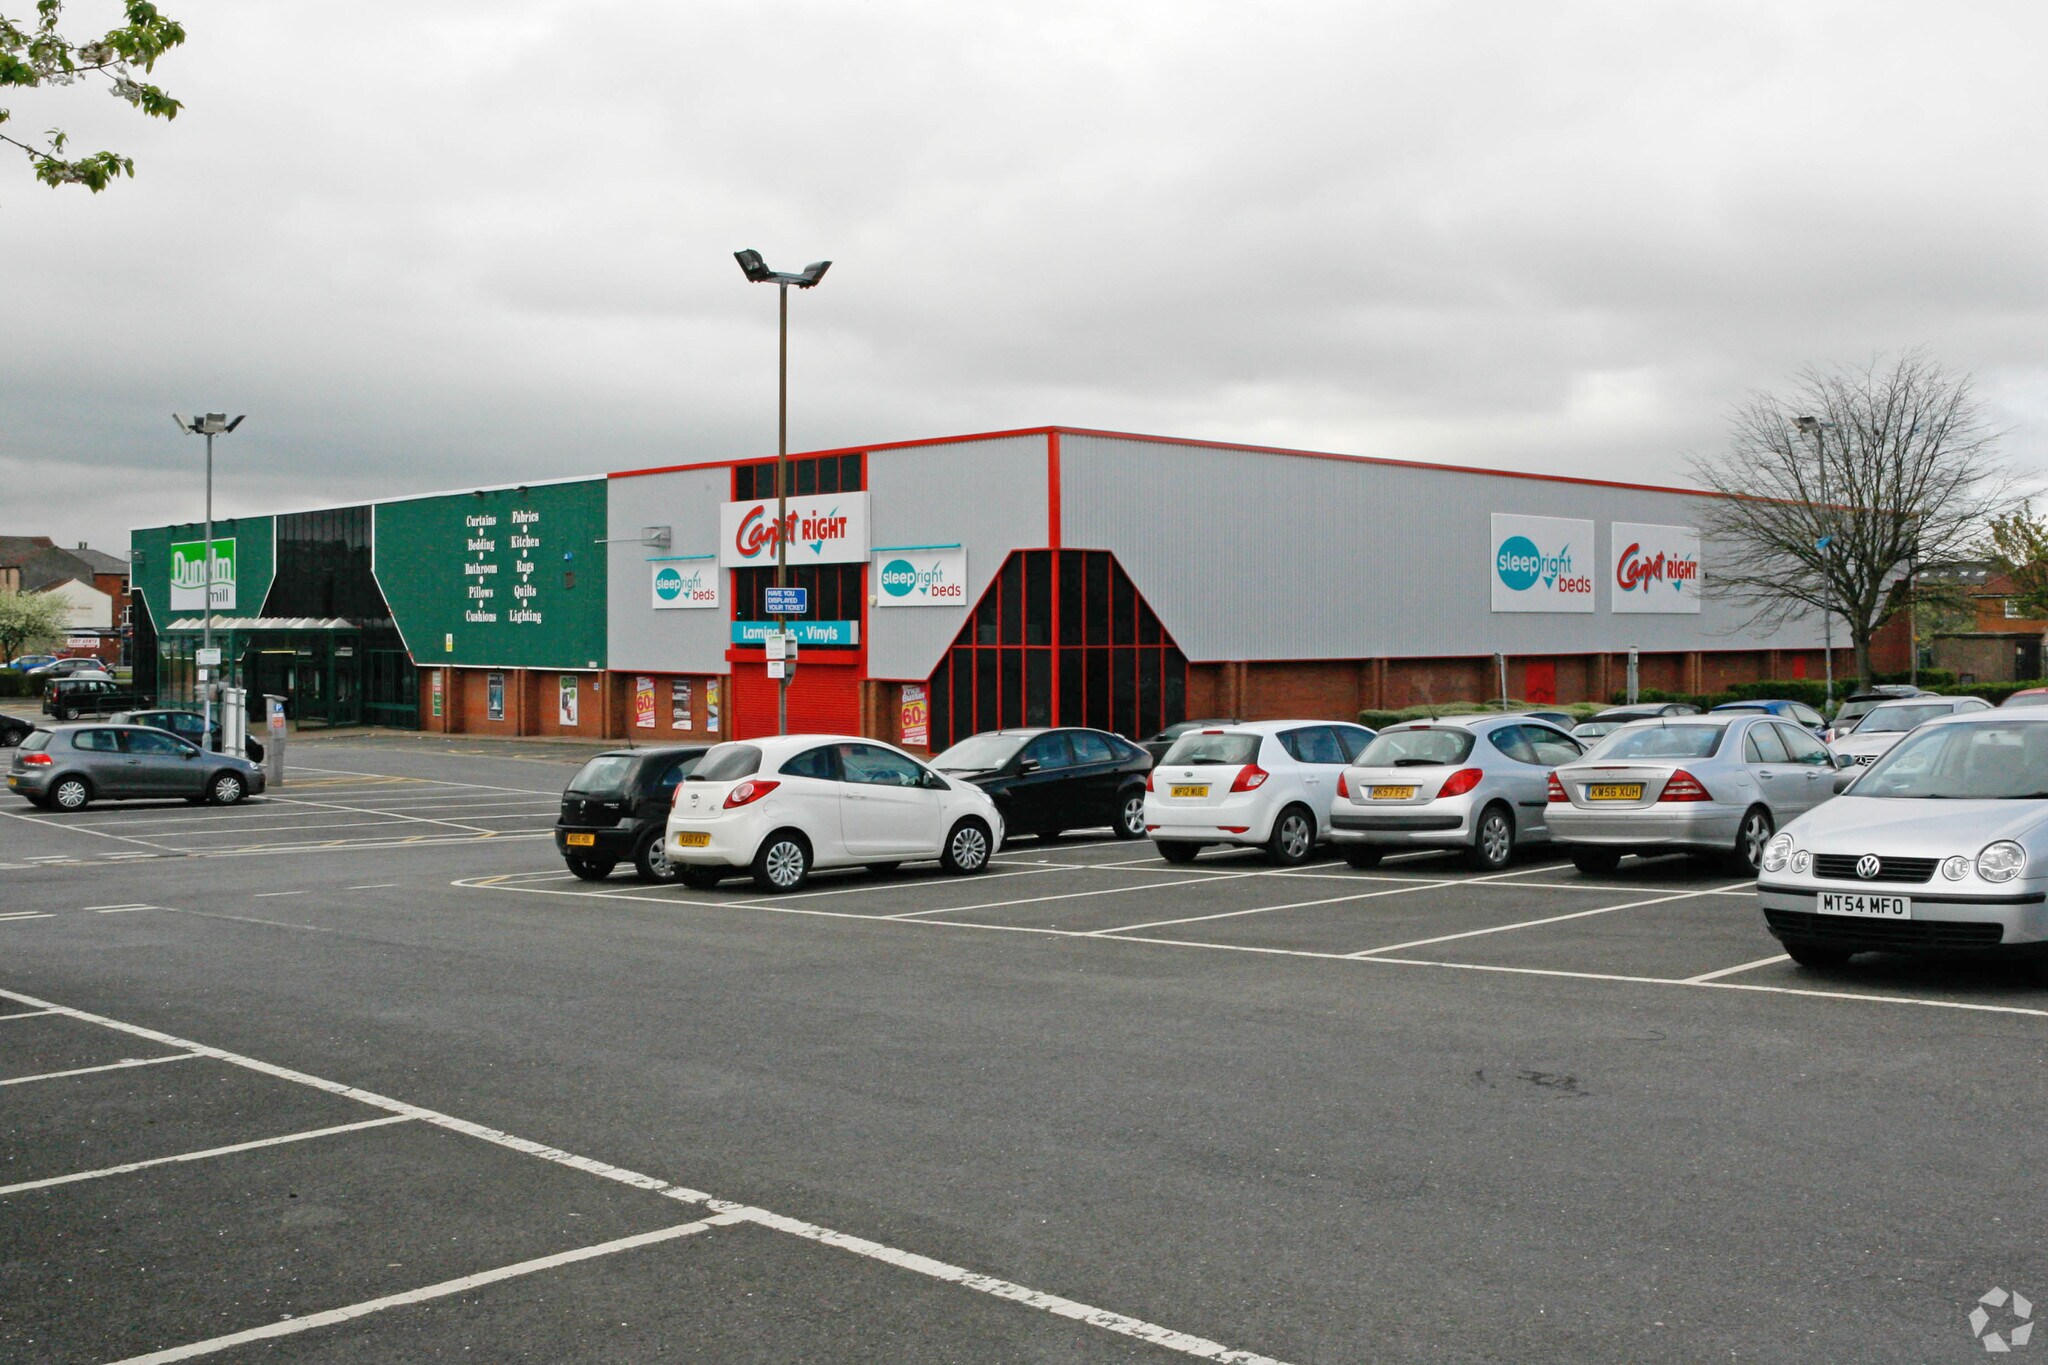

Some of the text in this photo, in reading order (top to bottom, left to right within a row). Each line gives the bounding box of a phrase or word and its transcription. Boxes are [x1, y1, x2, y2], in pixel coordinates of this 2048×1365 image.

[466, 514, 497, 527] Curtains
[512, 510, 539, 523] Fabrics
[802, 510, 847, 540] RIGHT
[468, 538, 496, 552] Bedding
[511, 534, 540, 548] Kitchen
[465, 562, 498, 575] Bathroom
[516, 560, 535, 574] Rugs
[1617, 542, 1697, 594] Carpet RIGHT
[931, 583, 961, 597] beds
[1559, 574, 1591, 593] beds
[468, 586, 494, 599] Pillows
[514, 584, 537, 600] Quilts
[692, 588, 715, 601] beds
[465, 609, 497, 622] Cushions
[509, 609, 542, 625] Lighting
[806, 624, 839, 644] Vinyls
[1619, 787, 1639, 797] XUH
[1824, 894, 1903, 915] MT54 MFO
